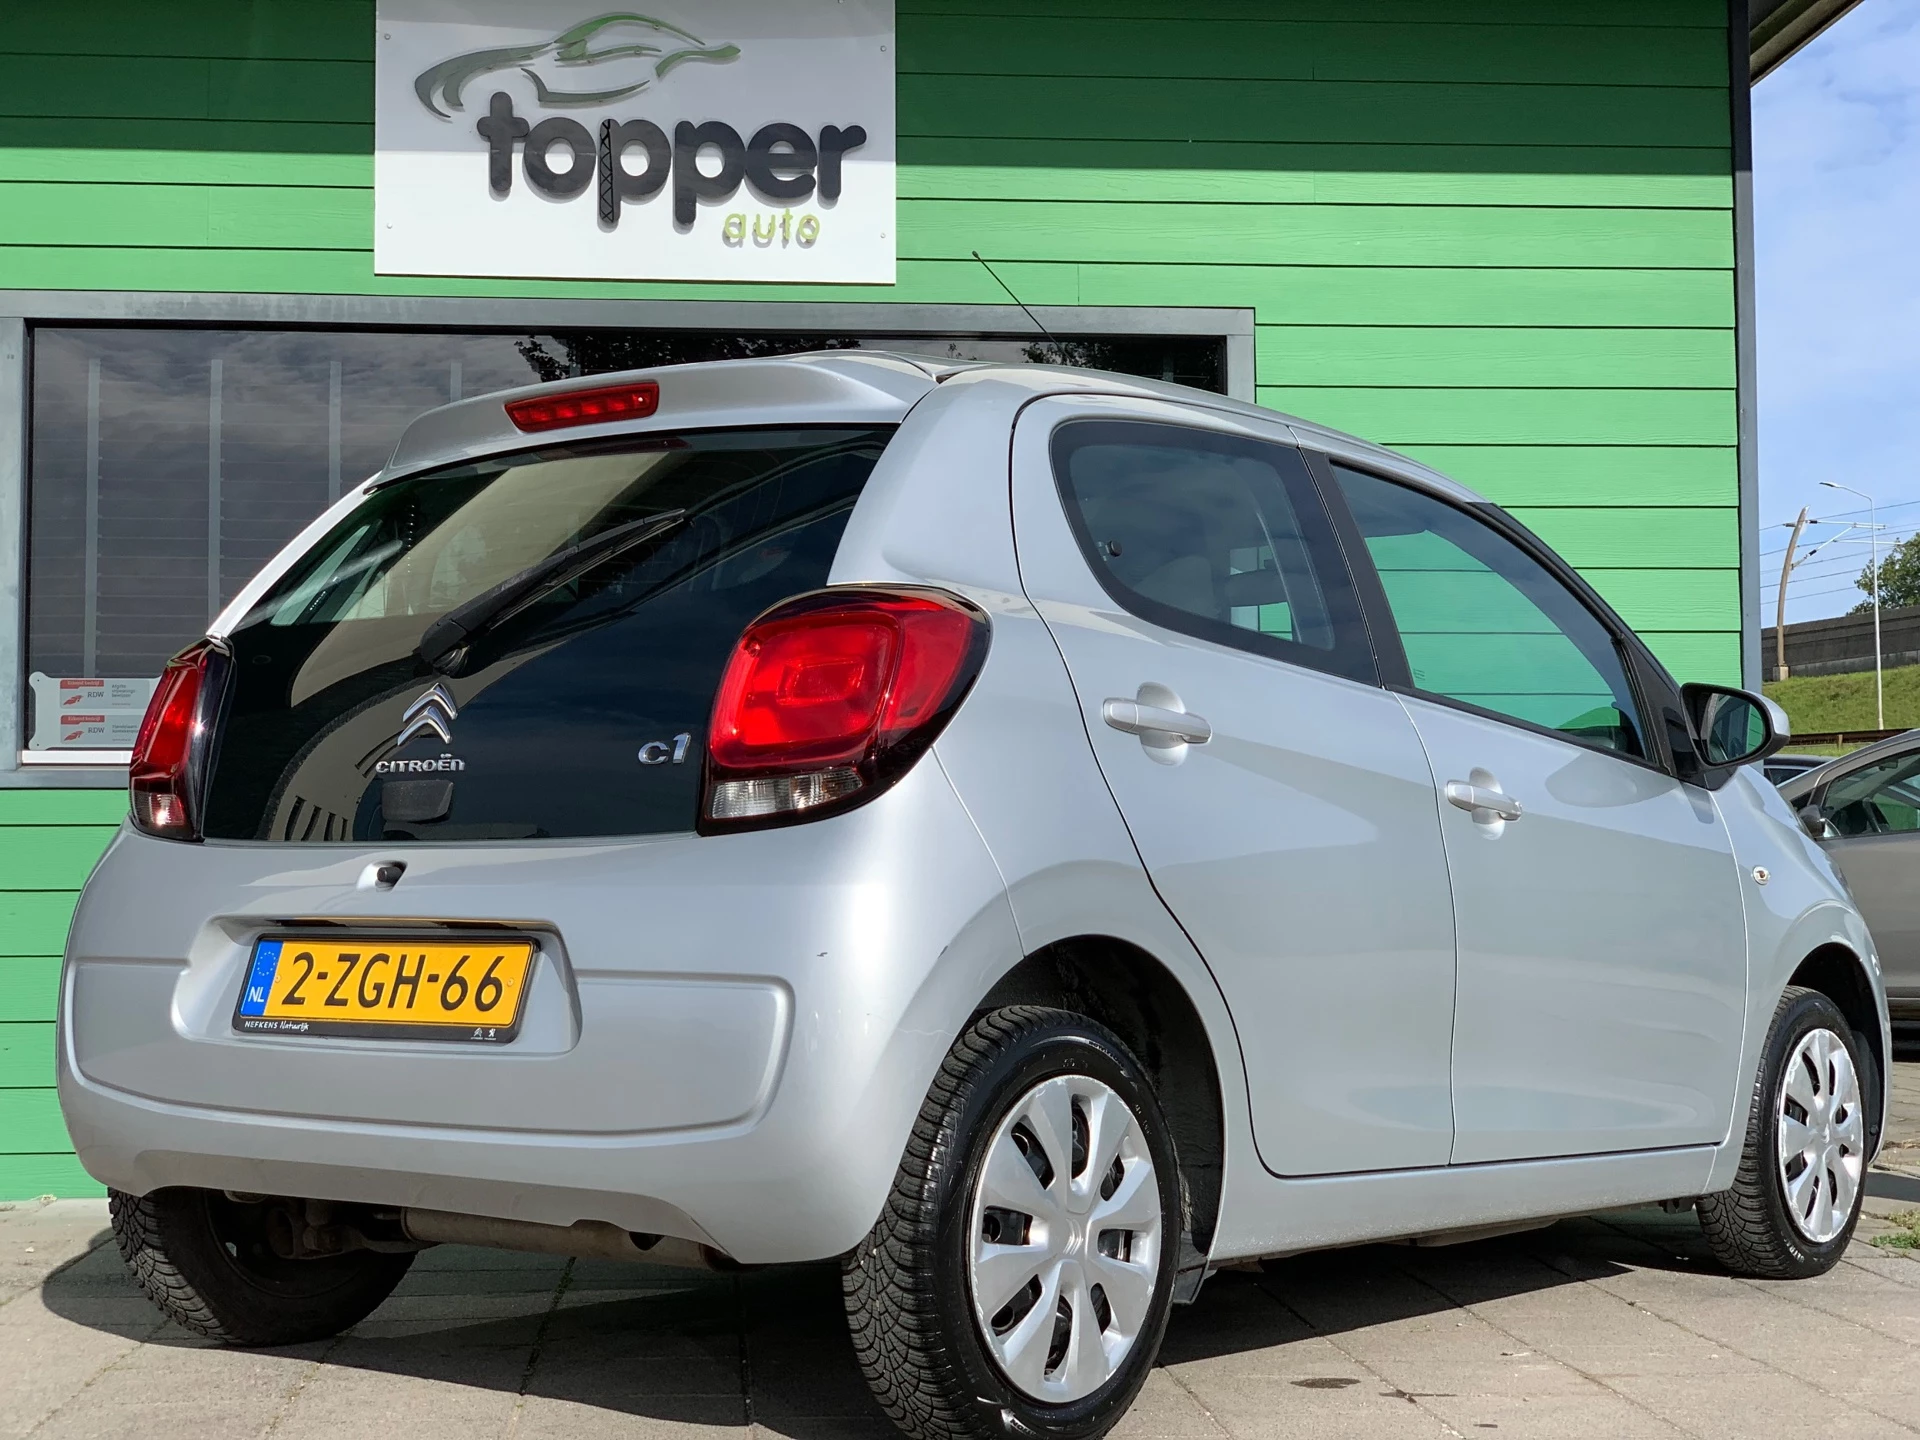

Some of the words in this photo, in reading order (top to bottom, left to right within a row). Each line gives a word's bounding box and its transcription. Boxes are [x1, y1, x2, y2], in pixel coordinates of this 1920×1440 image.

[476, 91, 867, 226] topper
[723, 207, 821, 241] auto
[375, 753, 466, 774] CITROËN
[247, 985, 265, 1003] NL
[281, 951, 505, 1012] 2-ZGH-66
[244, 1020, 278, 1029] NEFKENS
